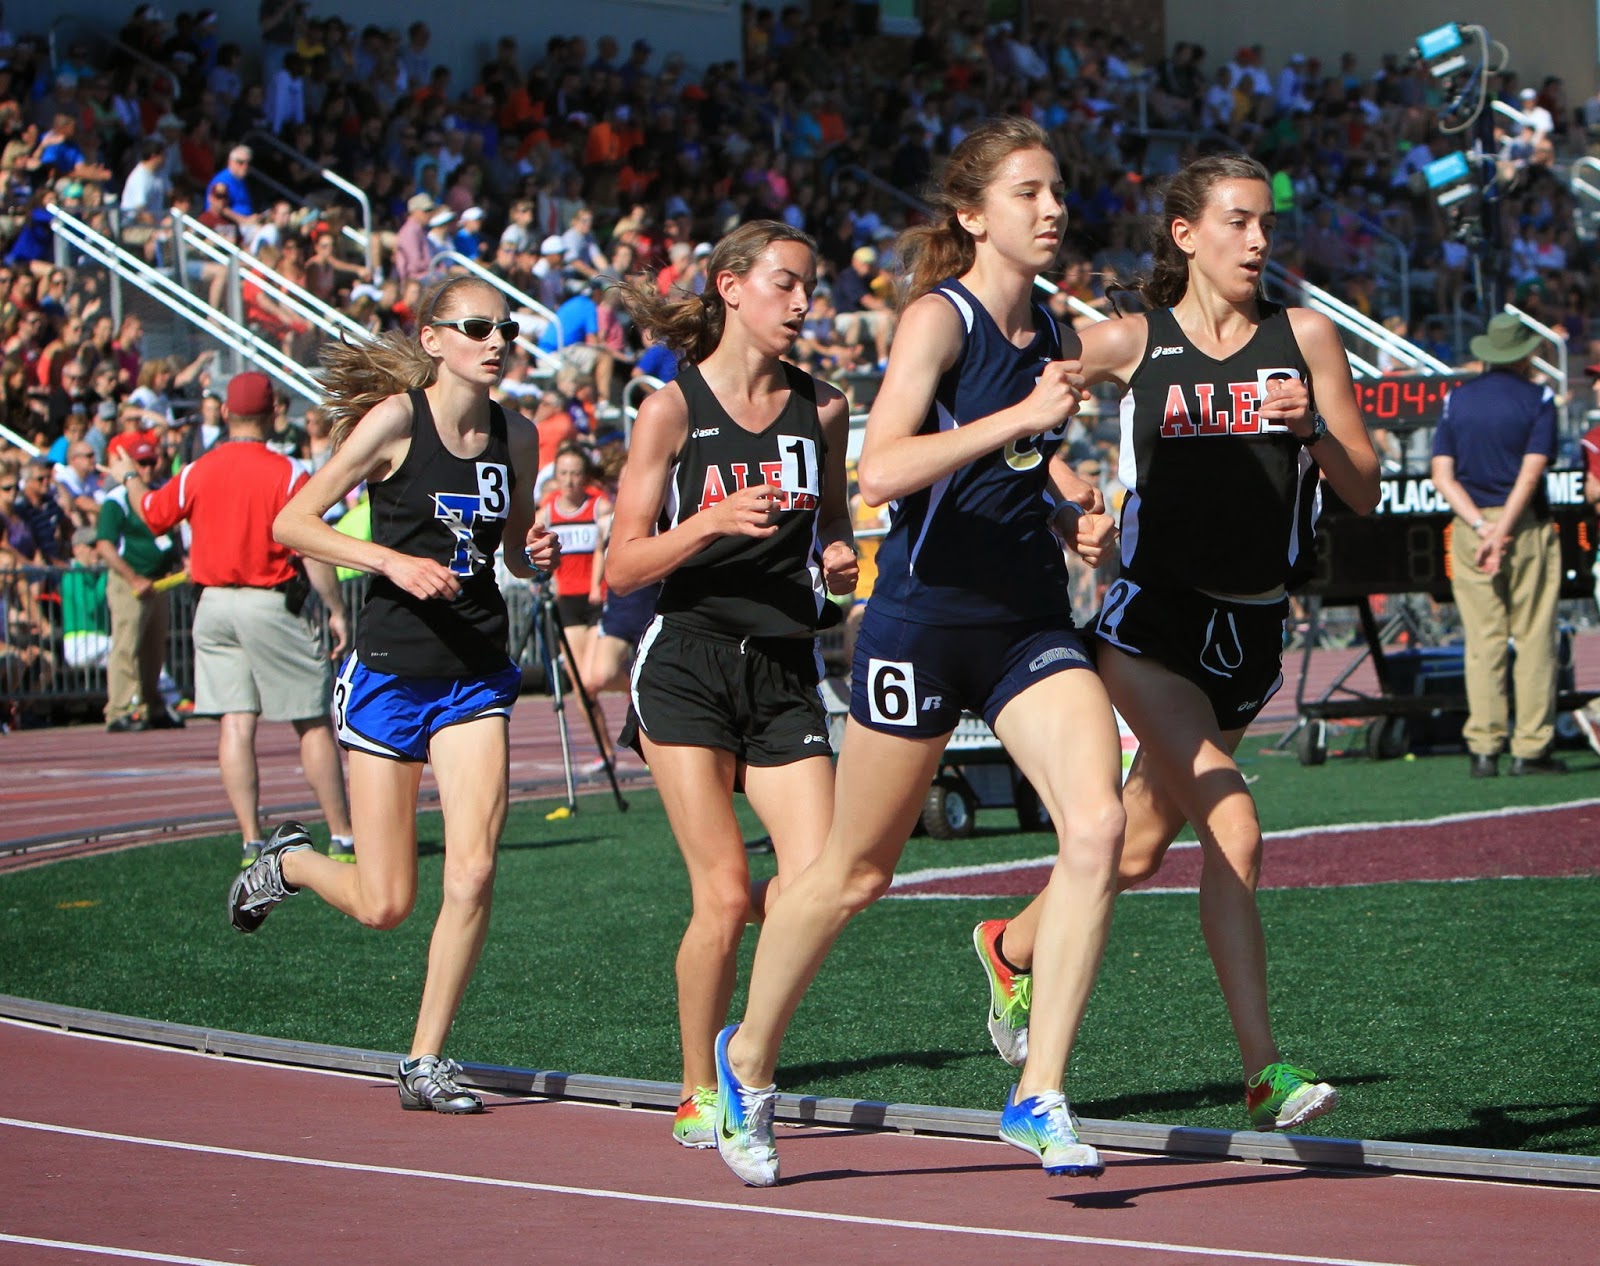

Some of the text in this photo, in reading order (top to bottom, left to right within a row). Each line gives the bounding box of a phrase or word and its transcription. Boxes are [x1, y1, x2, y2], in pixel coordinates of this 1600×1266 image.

[1161, 346, 1184, 355] asics
[699, 427, 720, 438] asics
[786, 440, 808, 489] 1
[482, 466, 506, 514] 3
[1099, 581, 1129, 636] 2
[335, 683, 346, 731] 3
[873, 665, 909, 721] 6
